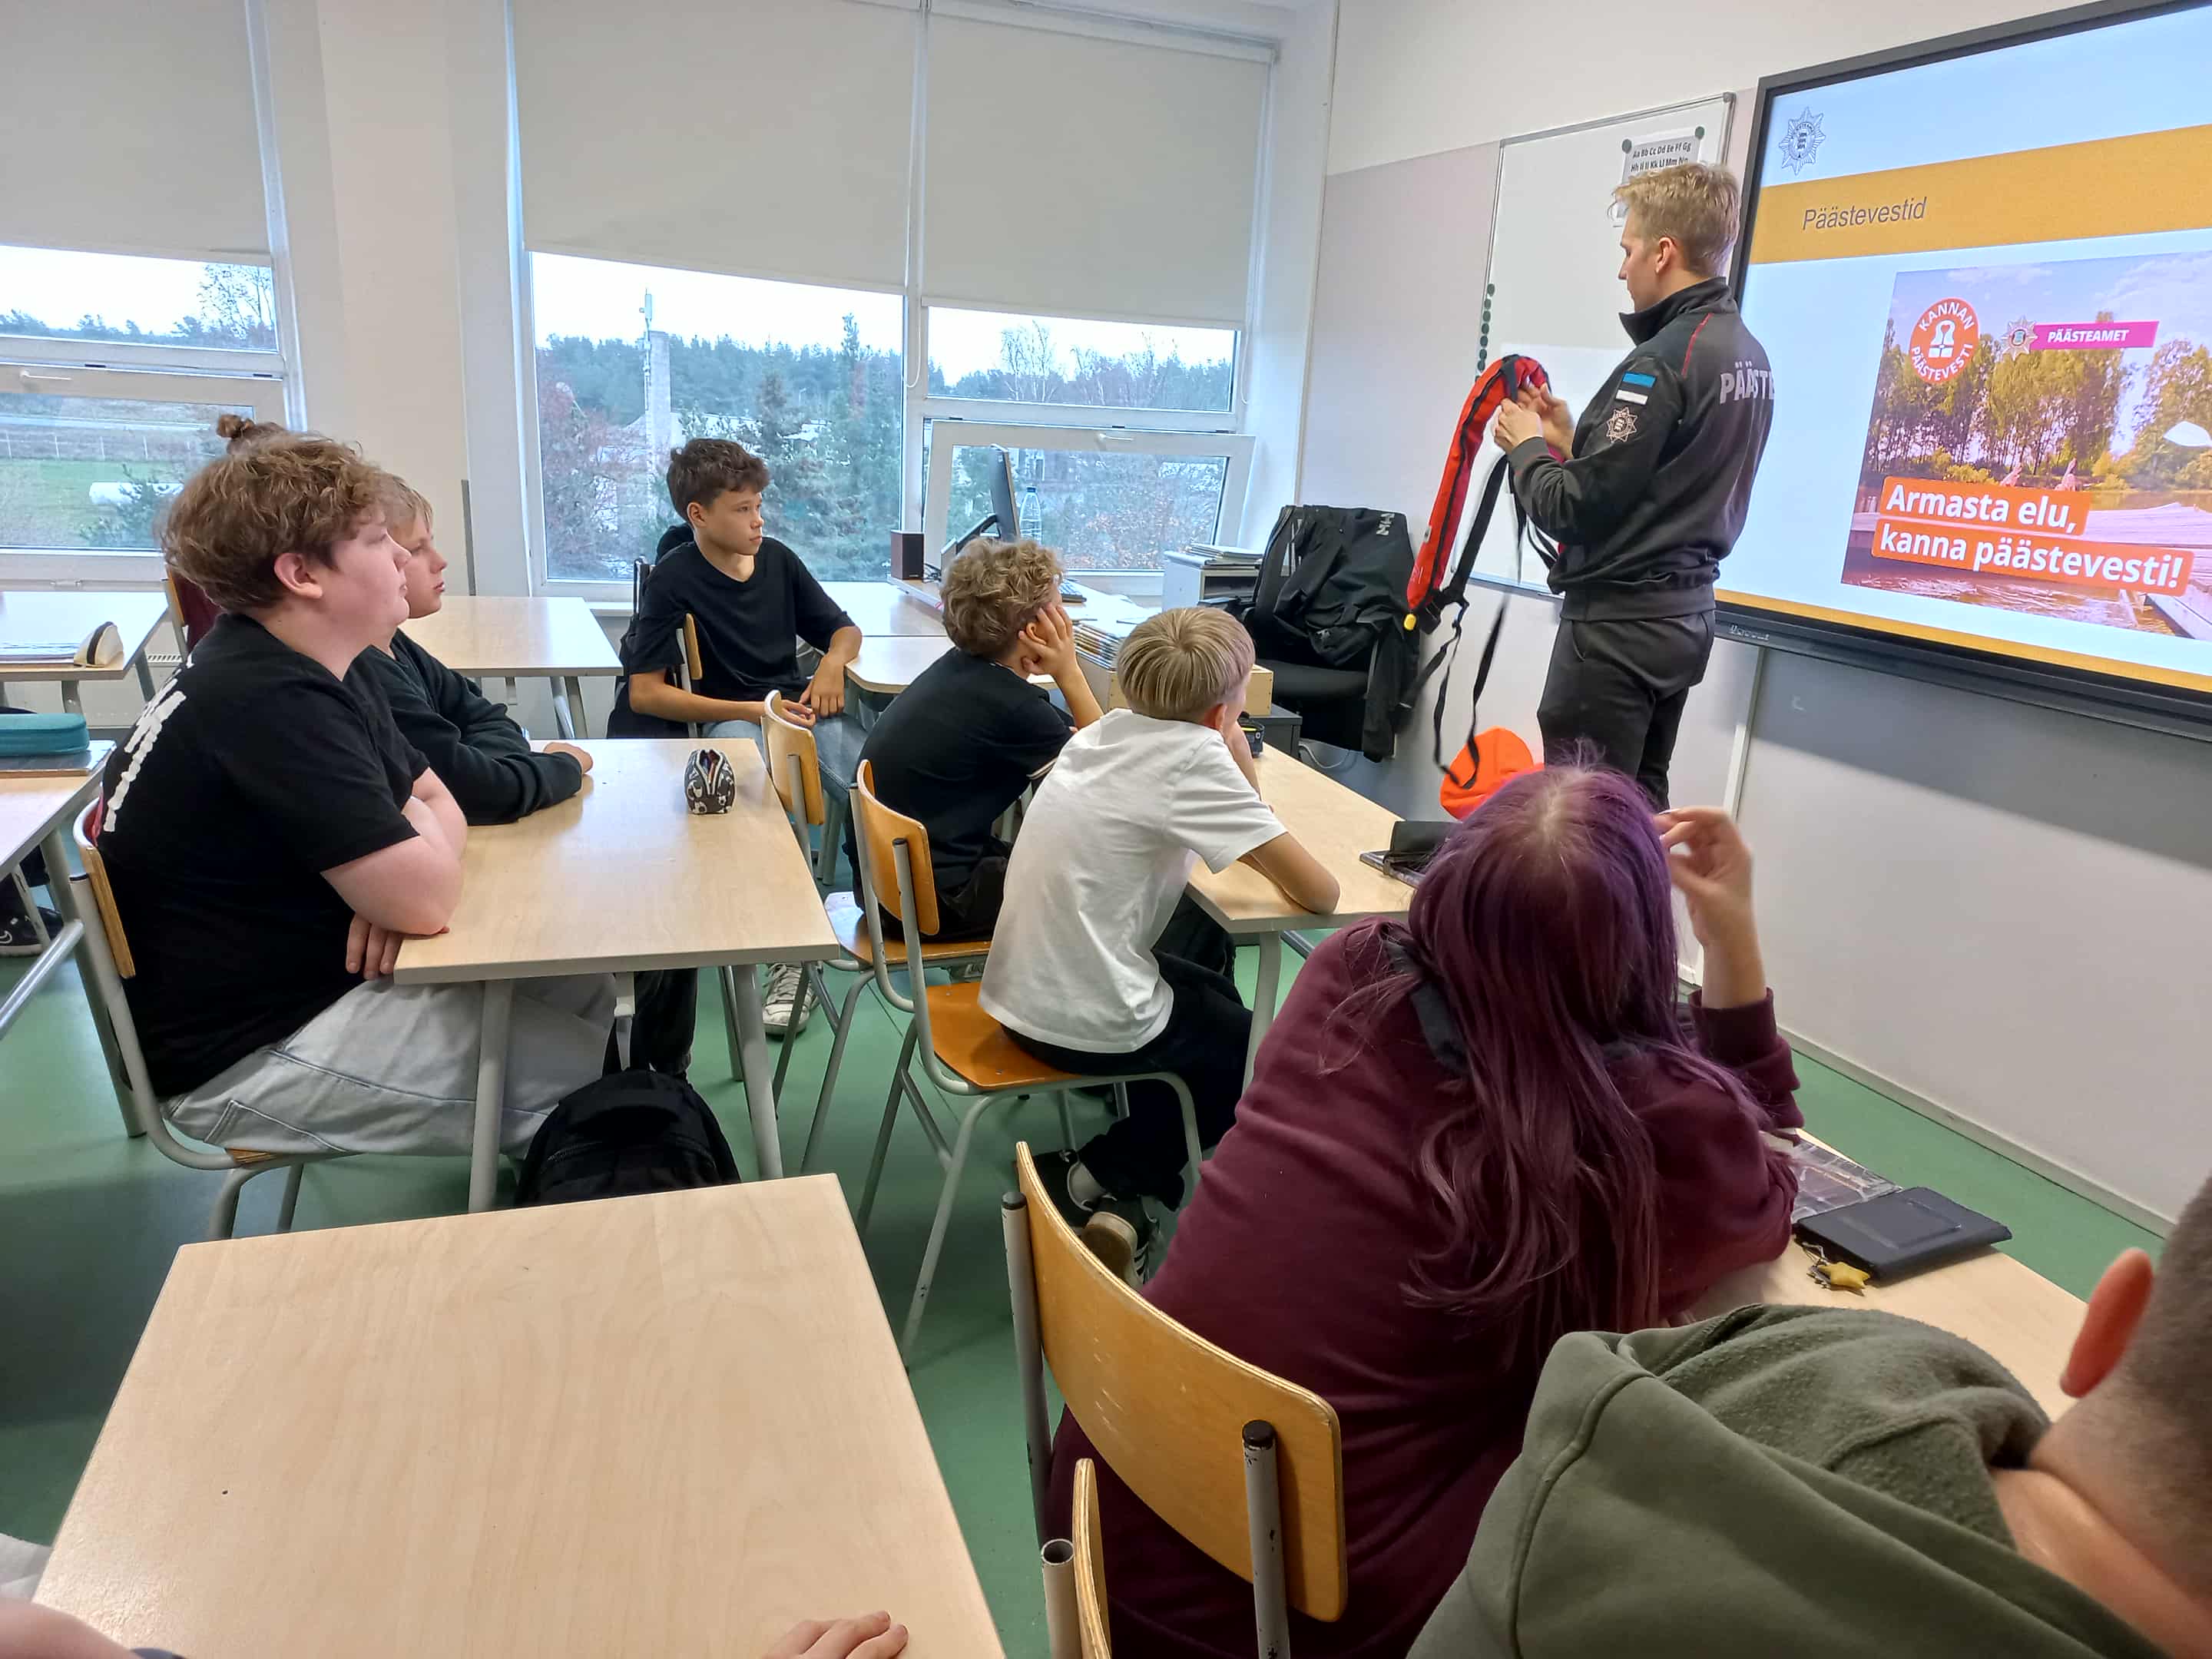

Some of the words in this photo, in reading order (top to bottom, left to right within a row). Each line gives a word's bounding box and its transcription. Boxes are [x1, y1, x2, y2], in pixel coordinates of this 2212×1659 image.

[1803, 196, 1927, 230] Päästevestid
[1919, 302, 1975, 332] KANNAN
[2047, 327, 2130, 343] PÄÄSTEAMET
[1911, 343, 1973, 381] PÄÄSTEVESTI
[1886, 484, 2009, 523] Armasta
[2018, 495, 2078, 534] elu,
[1879, 522, 1967, 561] kanna
[1972, 538, 2184, 589] päästevesti!
